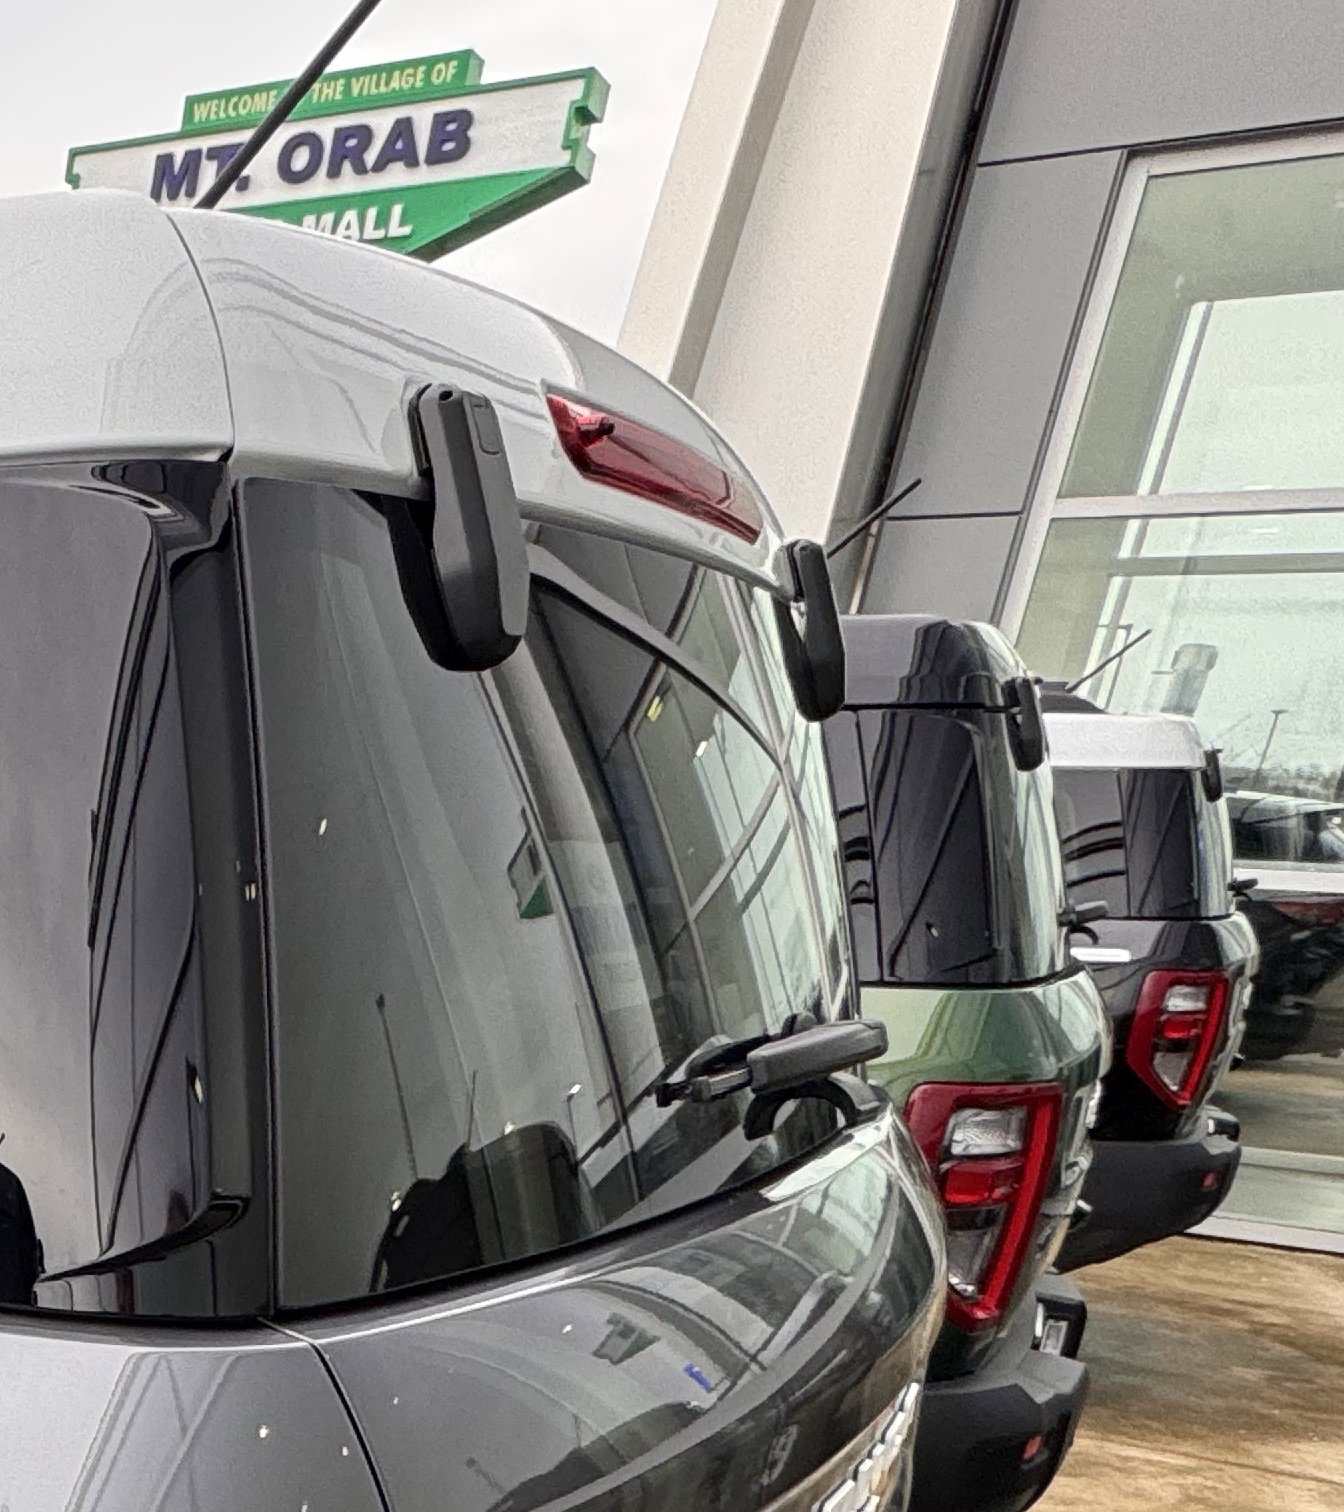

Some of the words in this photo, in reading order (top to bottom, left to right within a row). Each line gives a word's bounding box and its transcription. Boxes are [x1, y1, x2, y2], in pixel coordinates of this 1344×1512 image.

[192, 89, 278, 123] WELCOME
[312, 78, 345, 103] THE
[350, 65, 424, 98] VILLAGE
[430, 60, 459, 85] OF
[150, 142, 251, 201] MT.
[277, 108, 474, 185] ORAB
